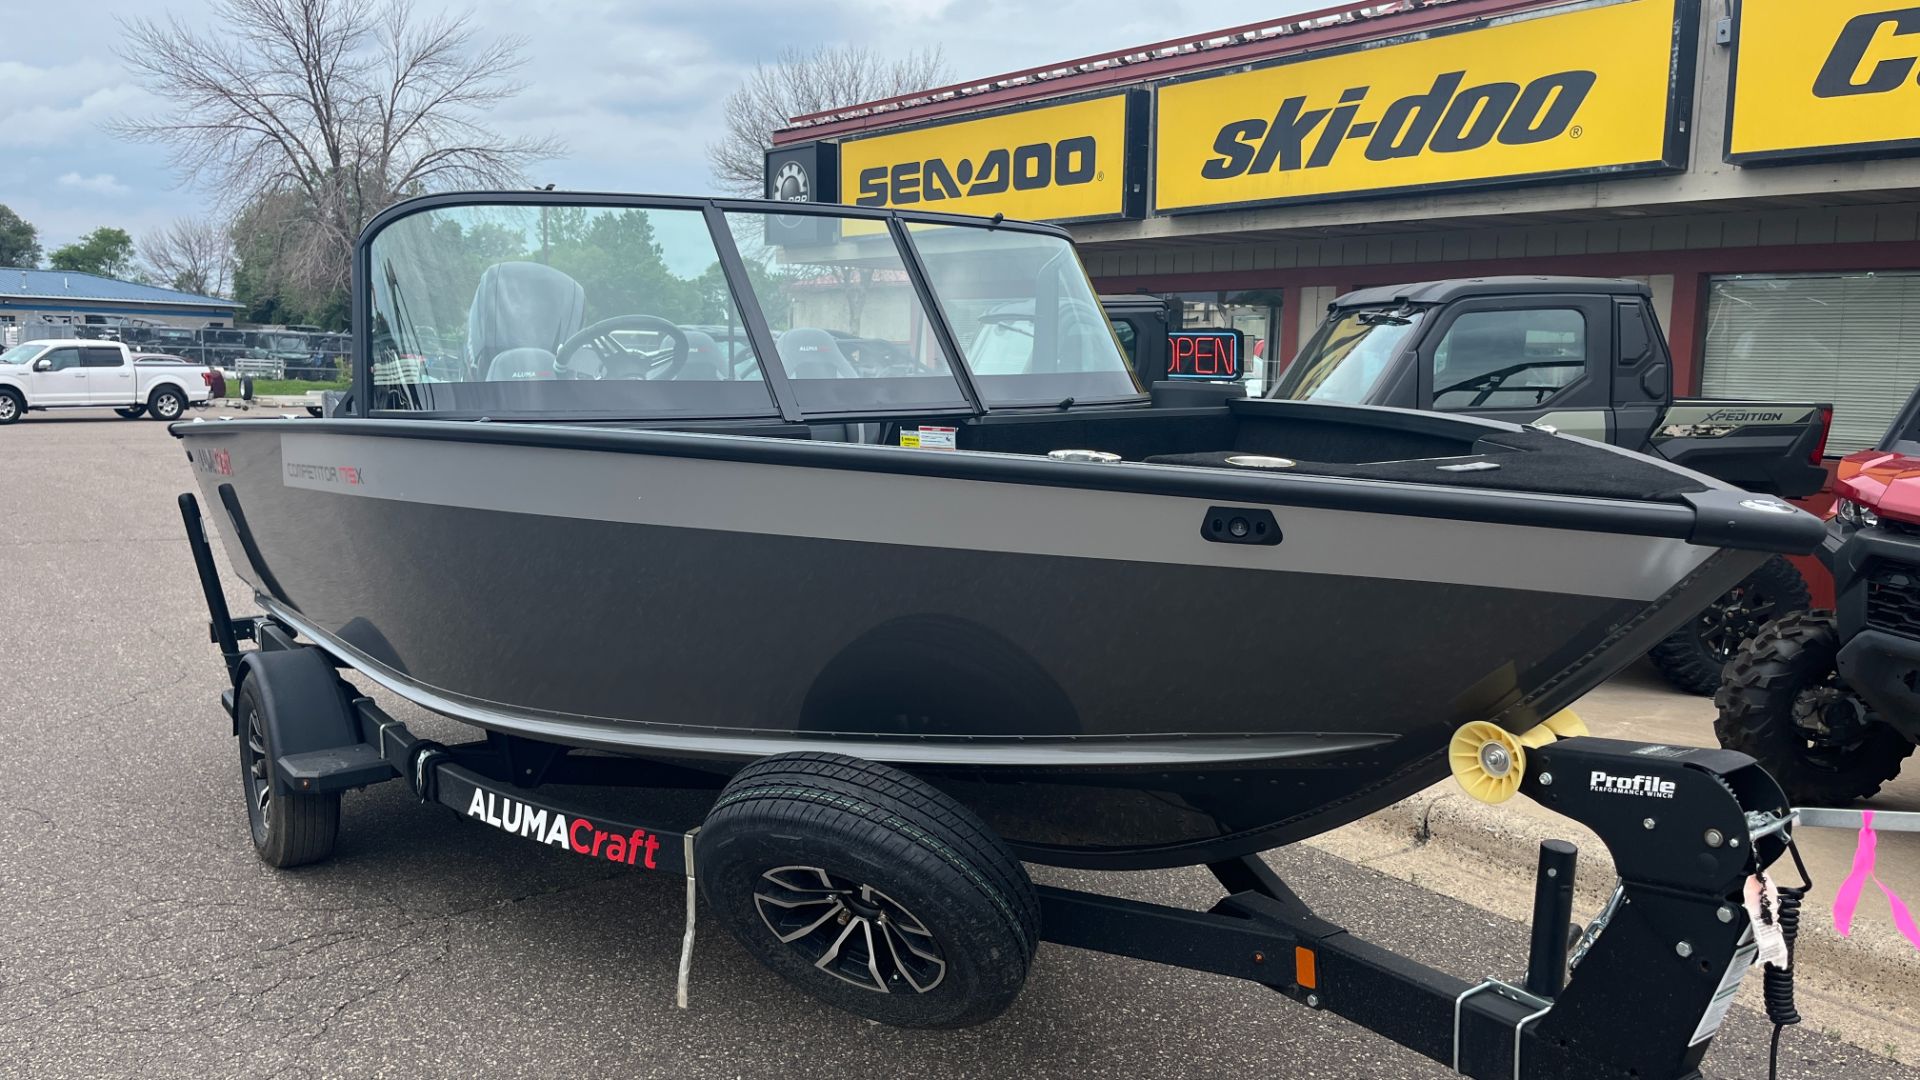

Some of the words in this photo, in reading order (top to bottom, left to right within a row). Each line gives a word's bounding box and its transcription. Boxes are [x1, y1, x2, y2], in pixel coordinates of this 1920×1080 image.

[1200, 70, 1597, 179] ski-doo
[1700, 409, 1784, 424] XPEDITION
[1590, 771, 1676, 794] Profile
[1590, 785, 1644, 797] PERFORMANCE
[1646, 791, 1674, 799] WINCH
[467, 787, 660, 869] ALUMACraft
